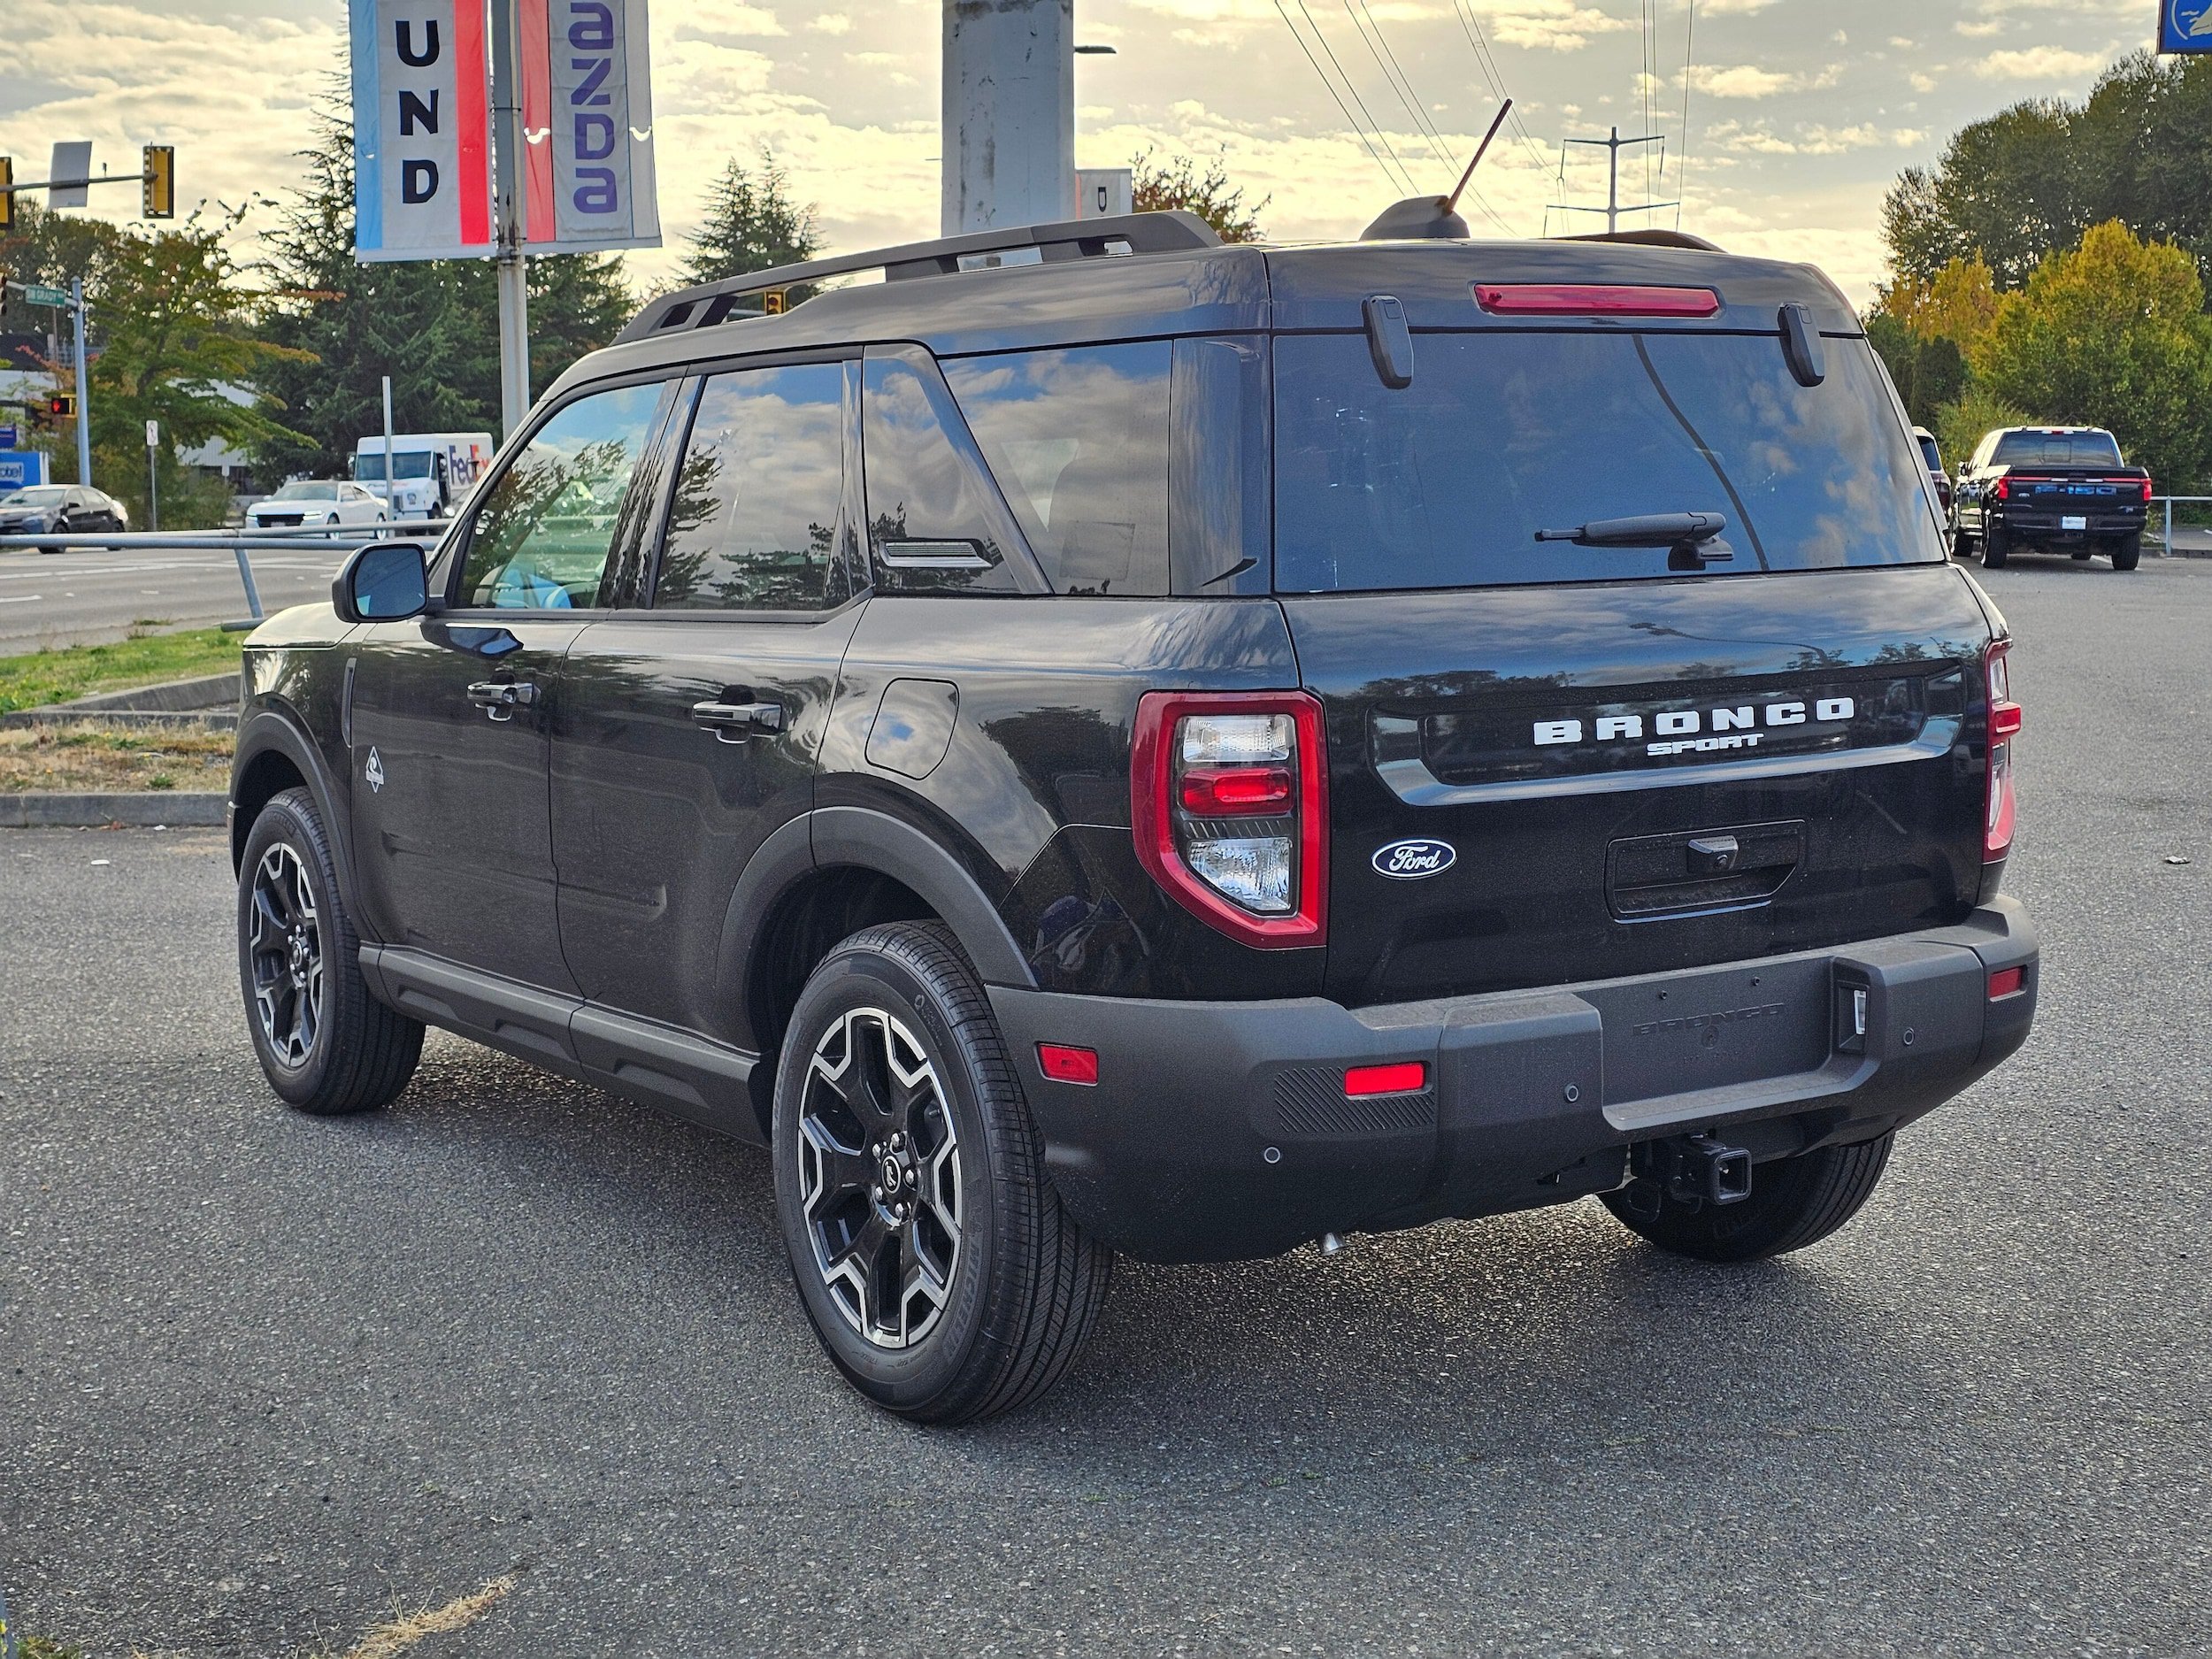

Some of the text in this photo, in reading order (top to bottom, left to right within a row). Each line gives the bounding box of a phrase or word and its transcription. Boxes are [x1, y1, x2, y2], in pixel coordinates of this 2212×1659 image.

[1533, 697, 1855, 745] BRONCO
[1647, 733, 1764, 757] SPORT
[1388, 845, 1441, 872] Ford
[1632, 1002, 1785, 1035] BRONCO
